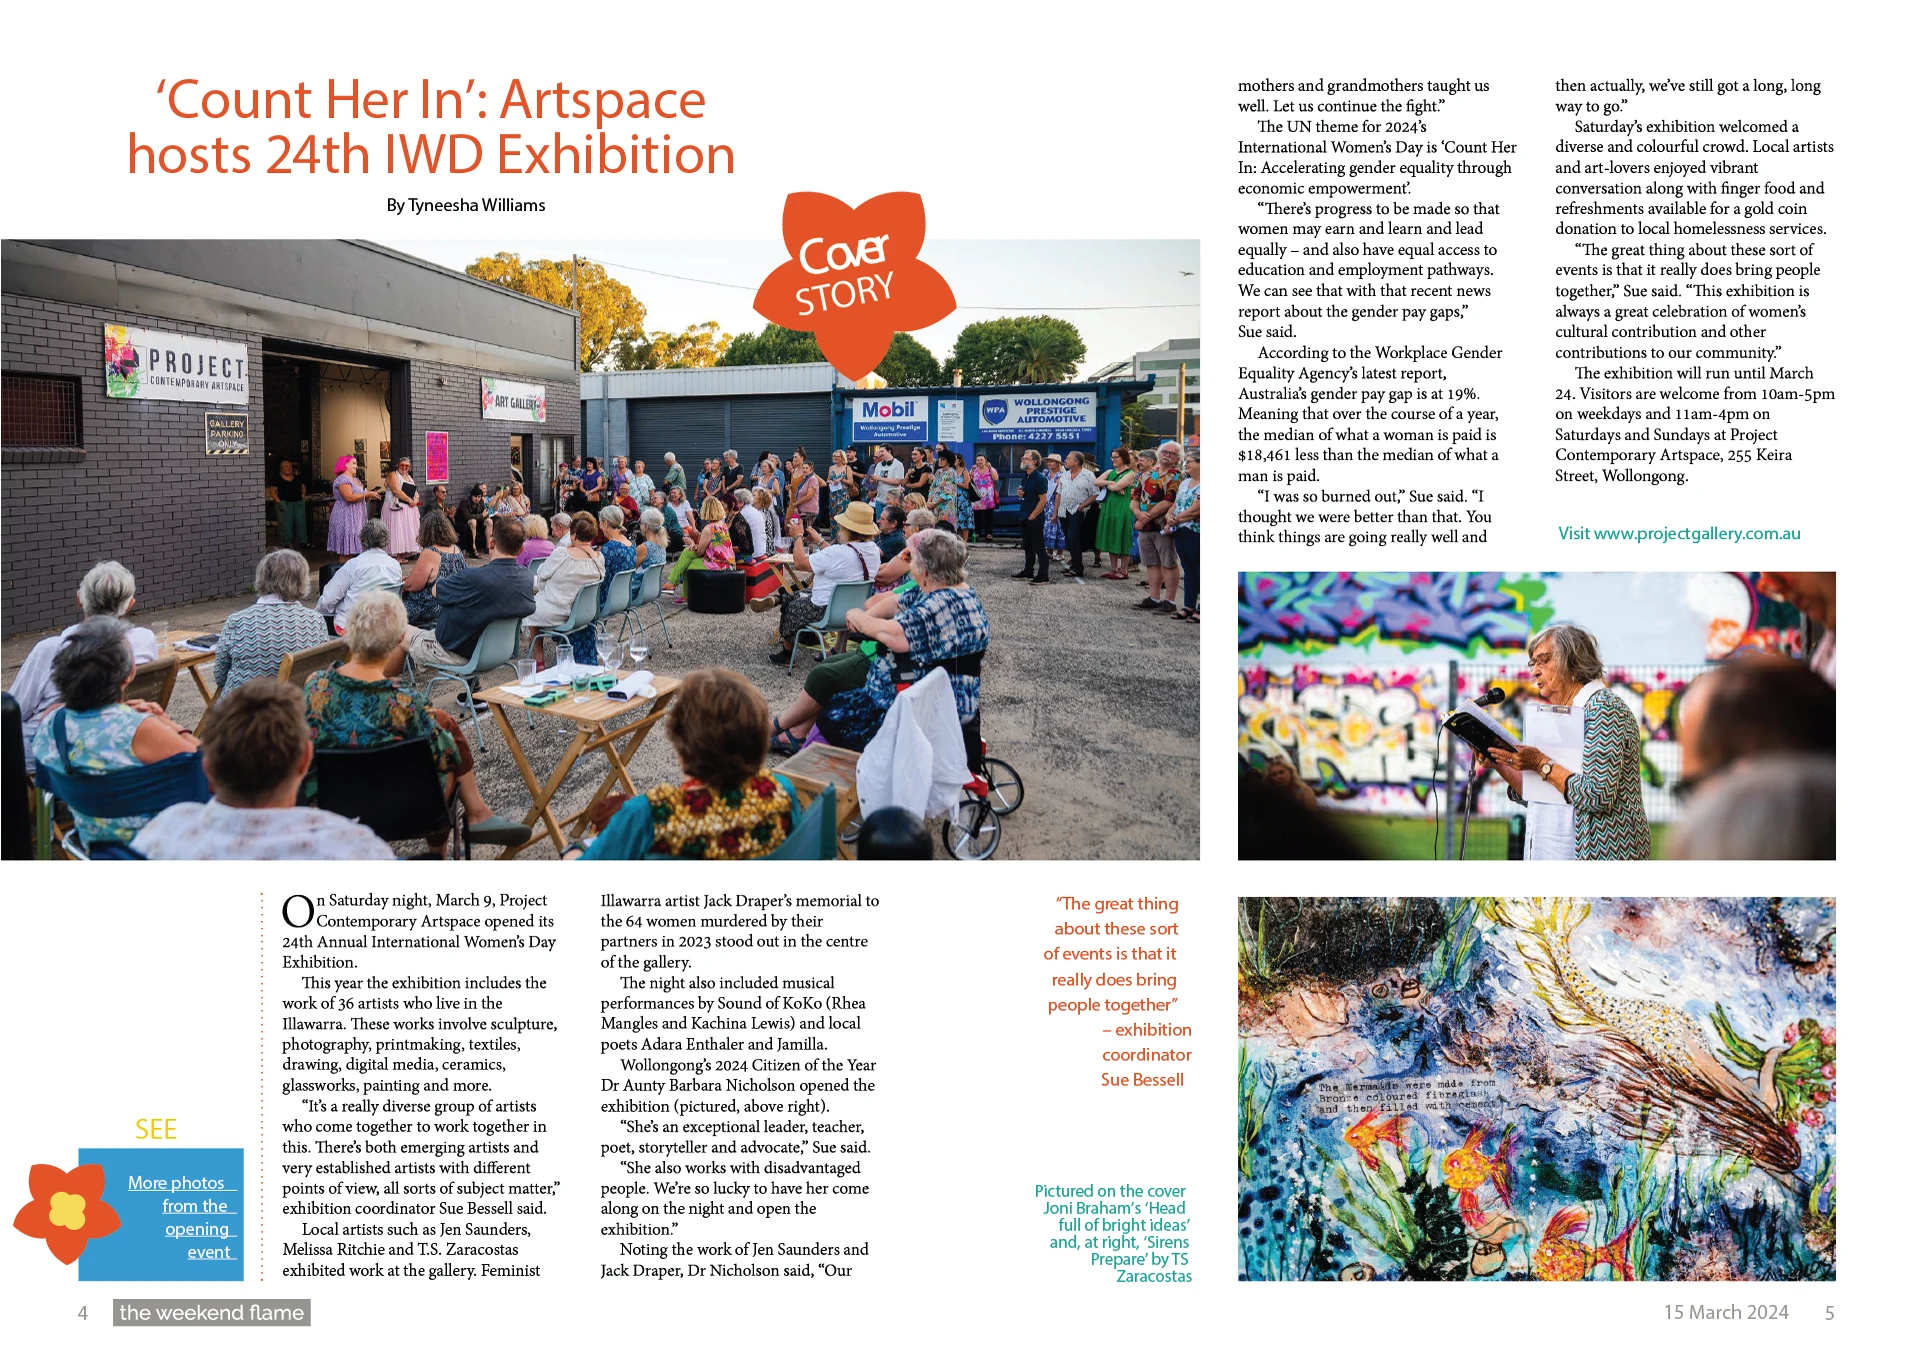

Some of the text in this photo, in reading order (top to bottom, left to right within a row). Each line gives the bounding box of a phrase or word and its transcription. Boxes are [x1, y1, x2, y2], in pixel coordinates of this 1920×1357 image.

[328, 78, 409, 119] Her
[499, 78, 706, 130] Artspace
[1257, 119, 1284, 133] The
[1286, 120, 1313, 133] UN
[1315, 119, 1359, 133] theme
[1361, 119, 1382, 133] for
[1646, 119, 1716, 133] exhibition
[1718, 119, 1789, 133] welcomed
[1791, 123, 1800, 133] a
[129, 131, 734, 174] hosts 24th IWD Exhibition
[387, 197, 546, 216] By Tyneesha Williams
[1257, 344, 1504, 363] According to the Workplace Gender
[149, 348, 244, 379] PROJECT
[150, 375, 244, 392] CONTEMPORARY ARTSPACE
[495, 394, 509, 407] ART
[1014, 396, 1090, 407] WOLLONGONG
[1555, 385, 1836, 404] 24. Visitors are welcome from 10am-5pm
[862, 400, 915, 418] Mobil
[986, 406, 1005, 414] WPA
[1026, 406, 1077, 415] PRESTIGE
[209, 419, 245, 429] GALLERY
[1016, 415, 1086, 424] AUTOMOTIVE
[210, 429, 244, 439] PARKING
[860, 424, 921, 433] Wollongong Prestige
[992, 432, 1080, 440] Phone: 4227 5551
[218, 440, 238, 450] ONLY
[1555, 447, 1793, 465] Contemporary Artspace, 255 Keira
[1555, 467, 1689, 486] Street, Wollongong.
[1558, 525, 1801, 544] Visit www.projectgallery.com.au
[600, 893, 662, 907] Illawarra
[664, 894, 701, 907] artist
[703, 893, 733, 910] Jack
[795, 893, 863, 907] memorial
[865, 895, 880, 907] to
[1094, 897, 1134, 915] great
[1137, 896, 1179, 915] thing
[1054, 921, 1179, 936] about these sort
[282, 934, 314, 949] 24th
[316, 934, 368, 949] Annual
[371, 934, 460, 949] International
[528, 935, 557, 952] Day
[282, 954, 358, 969] Exhibition.
[1043, 946, 1177, 961] of events is that it
[1052, 972, 1177, 991] really does bring
[1048, 997, 1101, 1016] people
[1115, 1022, 1192, 1037] exhibition
[281, 1036, 521, 1055] photography, printmaking, textiles,
[600, 1036, 828, 1055] poets Adara Enthaler and Jamilla.
[1102, 1047, 1193, 1062] coordinator
[1101, 1072, 1184, 1087] Sue Bessell
[1319, 1083, 1338, 1091] The
[1471, 1079, 1496, 1087] from
[1319, 1094, 1358, 1102] Bronze
[1366, 1092, 1418, 1101] coloured
[1348, 1104, 1372, 1112] then
[1380, 1103, 1418, 1111] filled
[1425, 1101, 1451, 1110] with
[135, 1117, 177, 1140] SEE
[662, 1123, 679, 1133] an
[682, 1119, 761, 1137] exceptional
[763, 1119, 809, 1135] leader,
[811, 1119, 865, 1135] teacher,
[128, 1176, 224, 1197] More photos
[1035, 1183, 1187, 1198] Pictured on the cover
[162, 1199, 228, 1213] from the
[1043, 1201, 1073, 1215] Joni
[165, 1222, 229, 1239] opening
[1058, 1217, 1081, 1232] full
[1084, 1217, 1101, 1232] of
[1102, 1217, 1147, 1235] bright
[1049, 1234, 1081, 1251] and,
[1084, 1235, 1099, 1249] at
[1102, 1234, 1140, 1252] right,
[188, 1246, 230, 1259] event
[1151, 1251, 1170, 1269] by
[1170, 1252, 1189, 1266] TS
[1116, 1269, 1193, 1283] Zaracostas
[77, 1305, 88, 1321] 4
[119, 1304, 305, 1321] the weekend flame
[1665, 1303, 1789, 1320] 15 March 2024
[1825, 1305, 1835, 1321] 5
